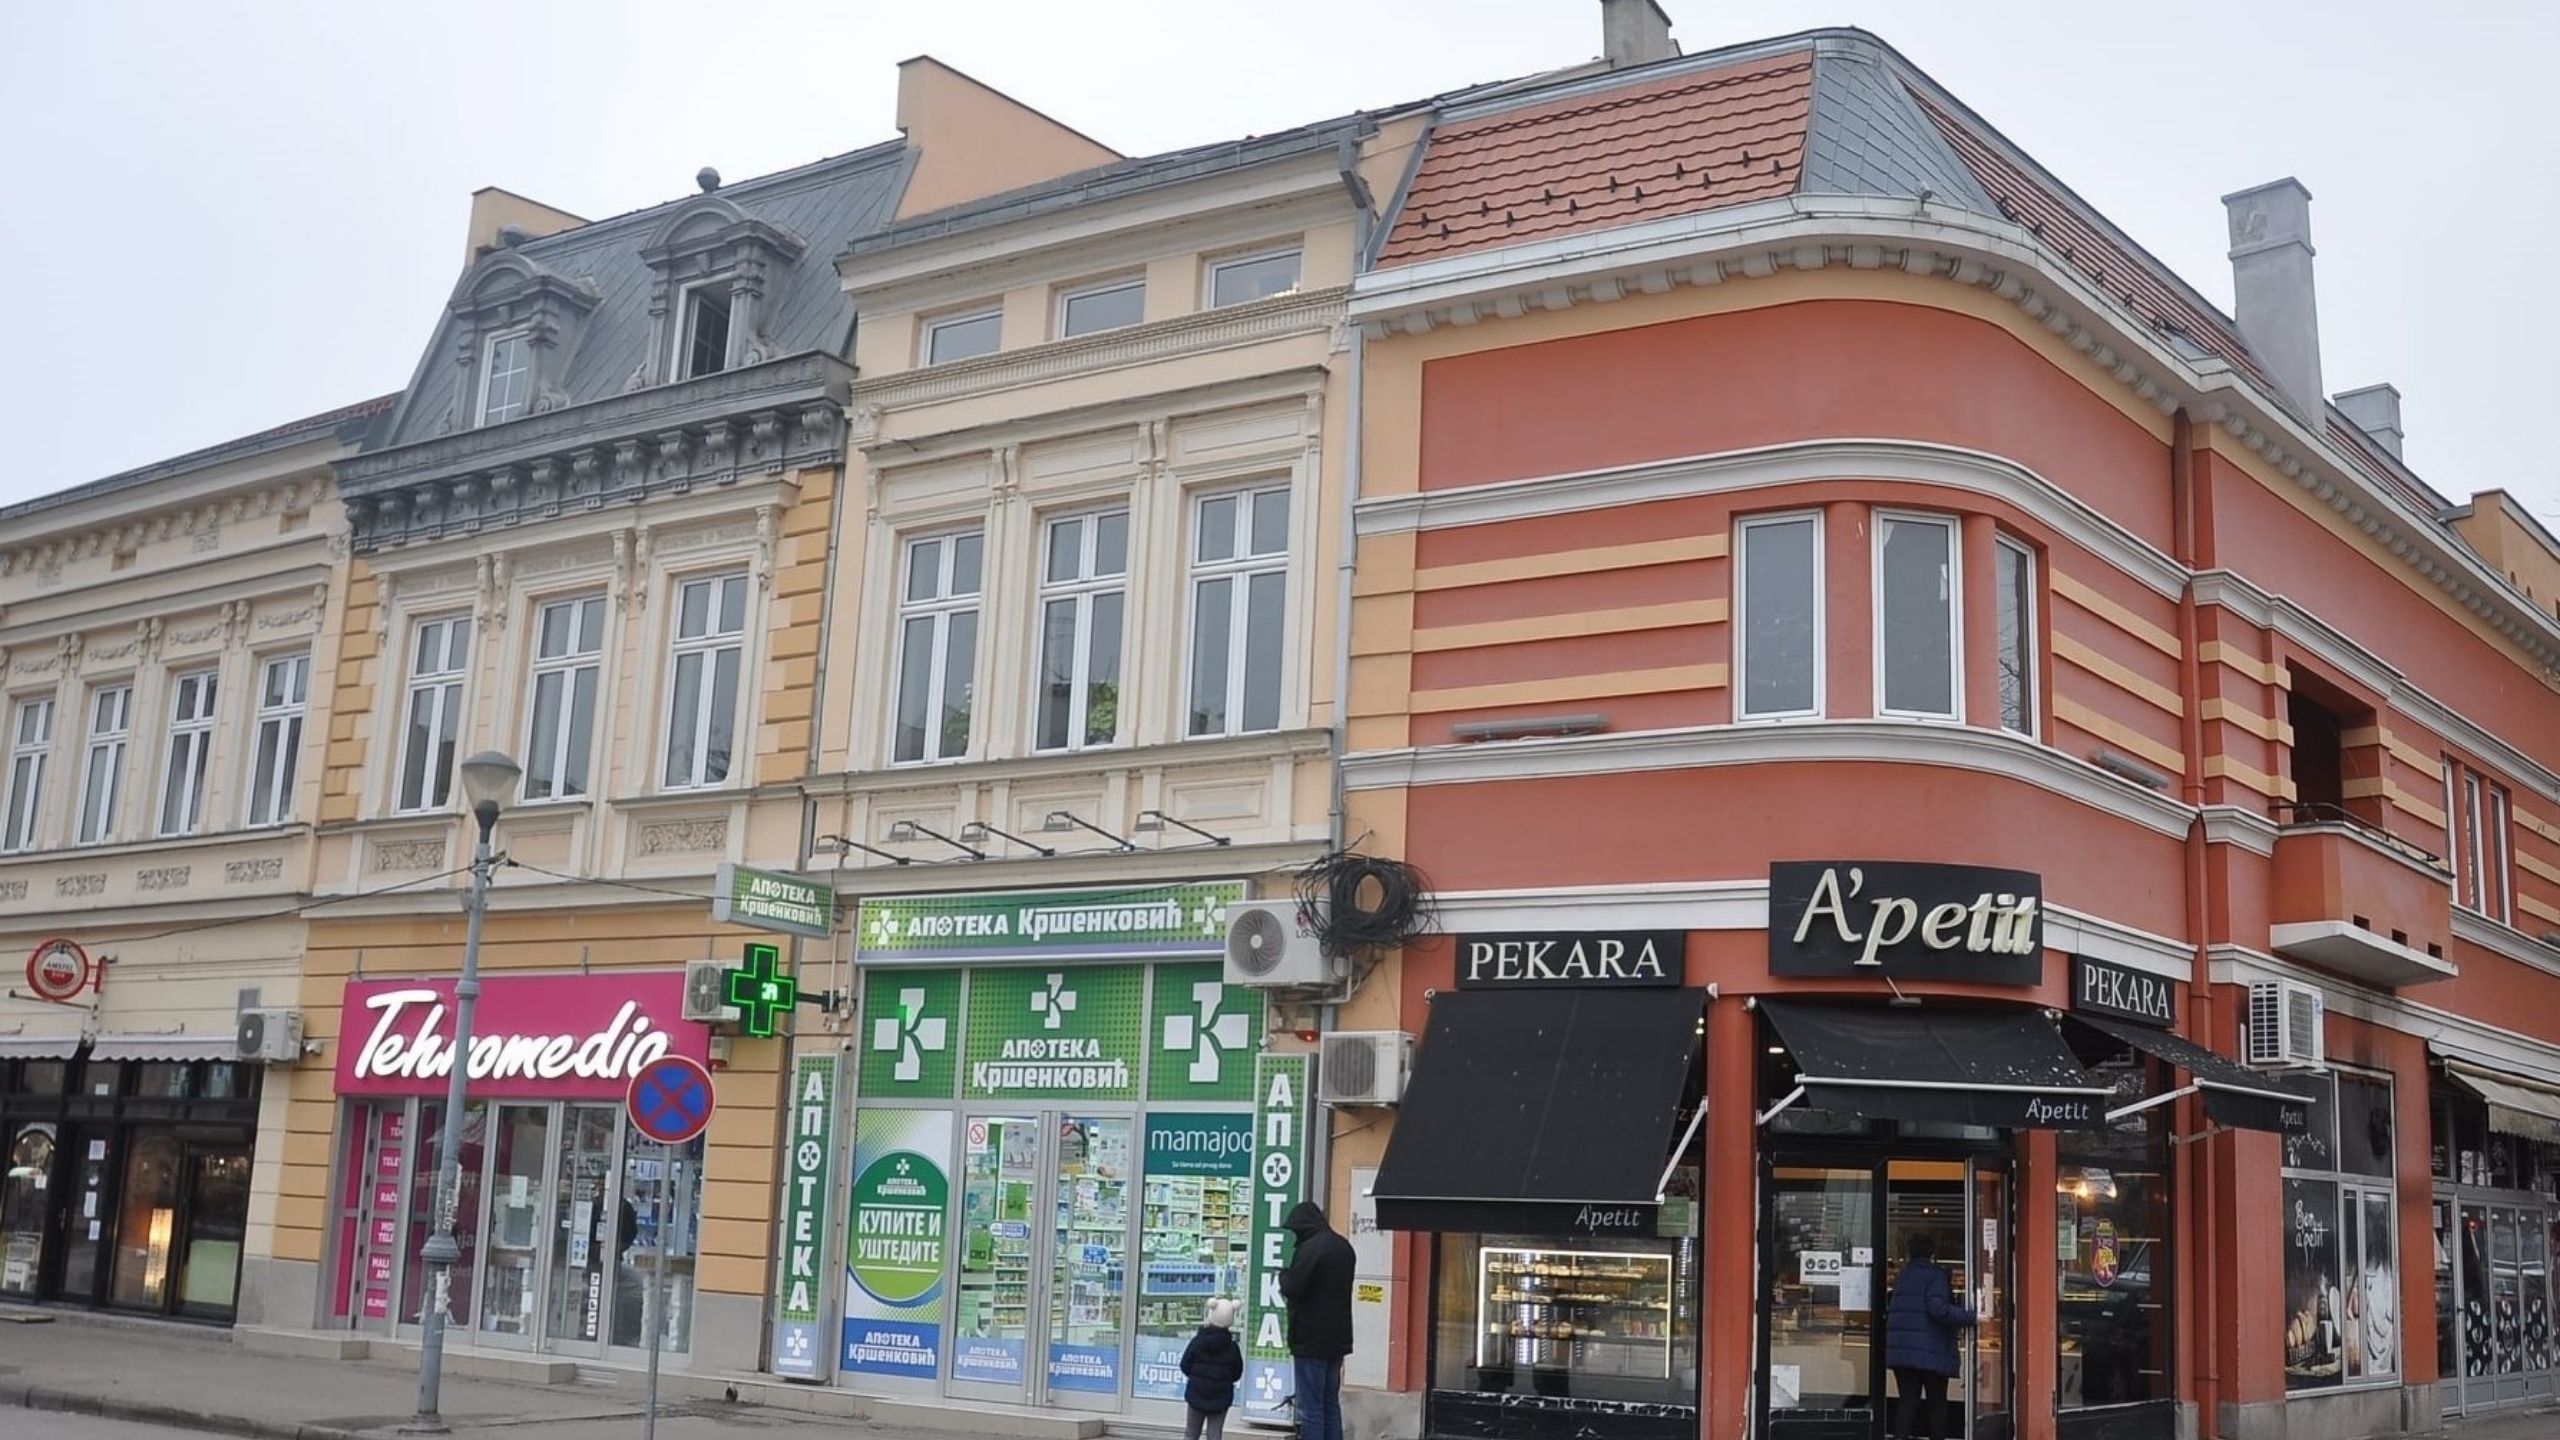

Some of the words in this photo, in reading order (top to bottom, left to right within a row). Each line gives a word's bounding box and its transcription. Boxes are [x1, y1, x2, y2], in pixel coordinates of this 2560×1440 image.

[751, 877, 815, 904] АПОТЕКА
[740, 895, 822, 926] Кршенковић
[908, 914, 1009, 937] АПОТЕКА
[1018, 898, 1182, 941] Кршенковић
[1792, 867, 2038, 966] A'petit
[1467, 938, 1665, 980] PEKARA
[2083, 963, 2170, 1019] PEKARA
[1002, 1038, 1100, 1059] АПОТЕКА
[972, 1058, 1128, 1094] Кршенковић
[2025, 1096, 2089, 1123] A'petit
[1151, 1125, 1253, 1159] mamajoo
[787, 1072, 824, 1312] АПОТЕКА
[858, 1210, 925, 1236] КУПИТЕ
[928, 1213, 941, 1236] И
[1256, 1073, 1294, 1348] АПОТЕКА
[1574, 1204, 1640, 1230] A'petit
[858, 1239, 940, 1265] УШТЕДИТЕ
[865, 1331, 921, 1347] АПОТЕКА
[969, 1346, 1008, 1358] АПОТЕКА
[848, 1343, 935, 1366] Кршенковић
[1060, 1353, 1102, 1365] АПОТЕКА
[1049, 1362, 1113, 1378] Кршенковић
